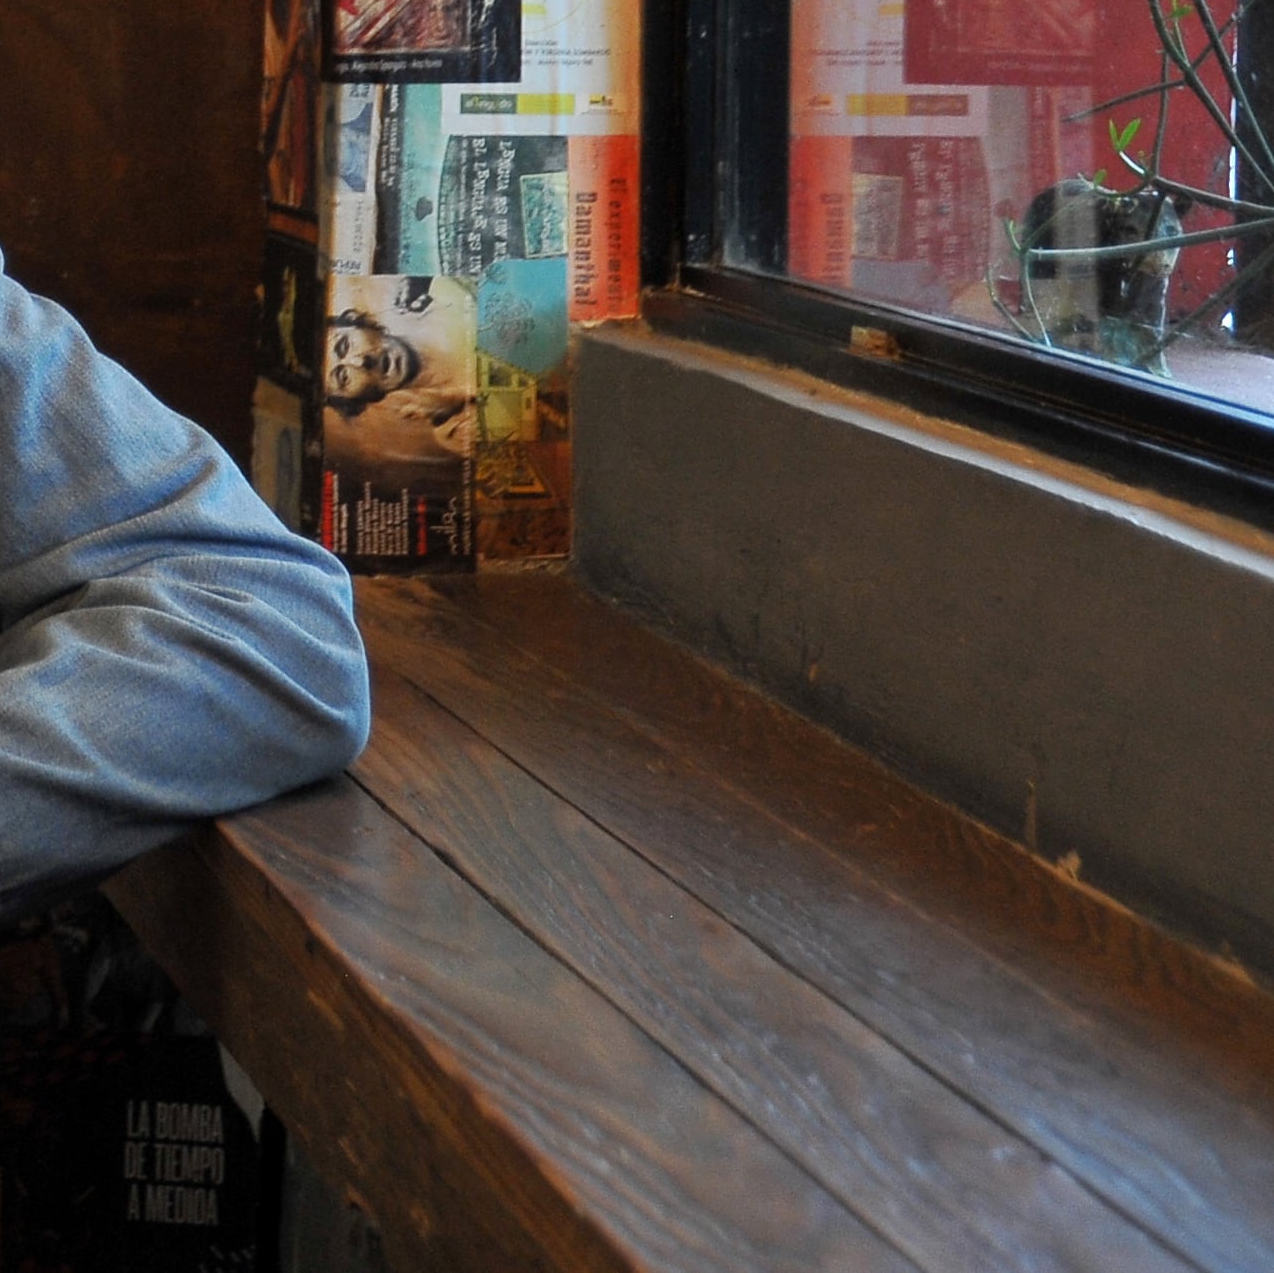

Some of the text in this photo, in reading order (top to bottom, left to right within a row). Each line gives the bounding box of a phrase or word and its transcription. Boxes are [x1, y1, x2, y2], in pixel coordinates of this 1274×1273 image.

[574, 192, 599, 305] Damanthal
[127, 1101, 223, 1143] LA BOMBA
[125, 1142, 224, 1185] DE TIEMPO
[127, 1185, 219, 1226] A MEDIDA
